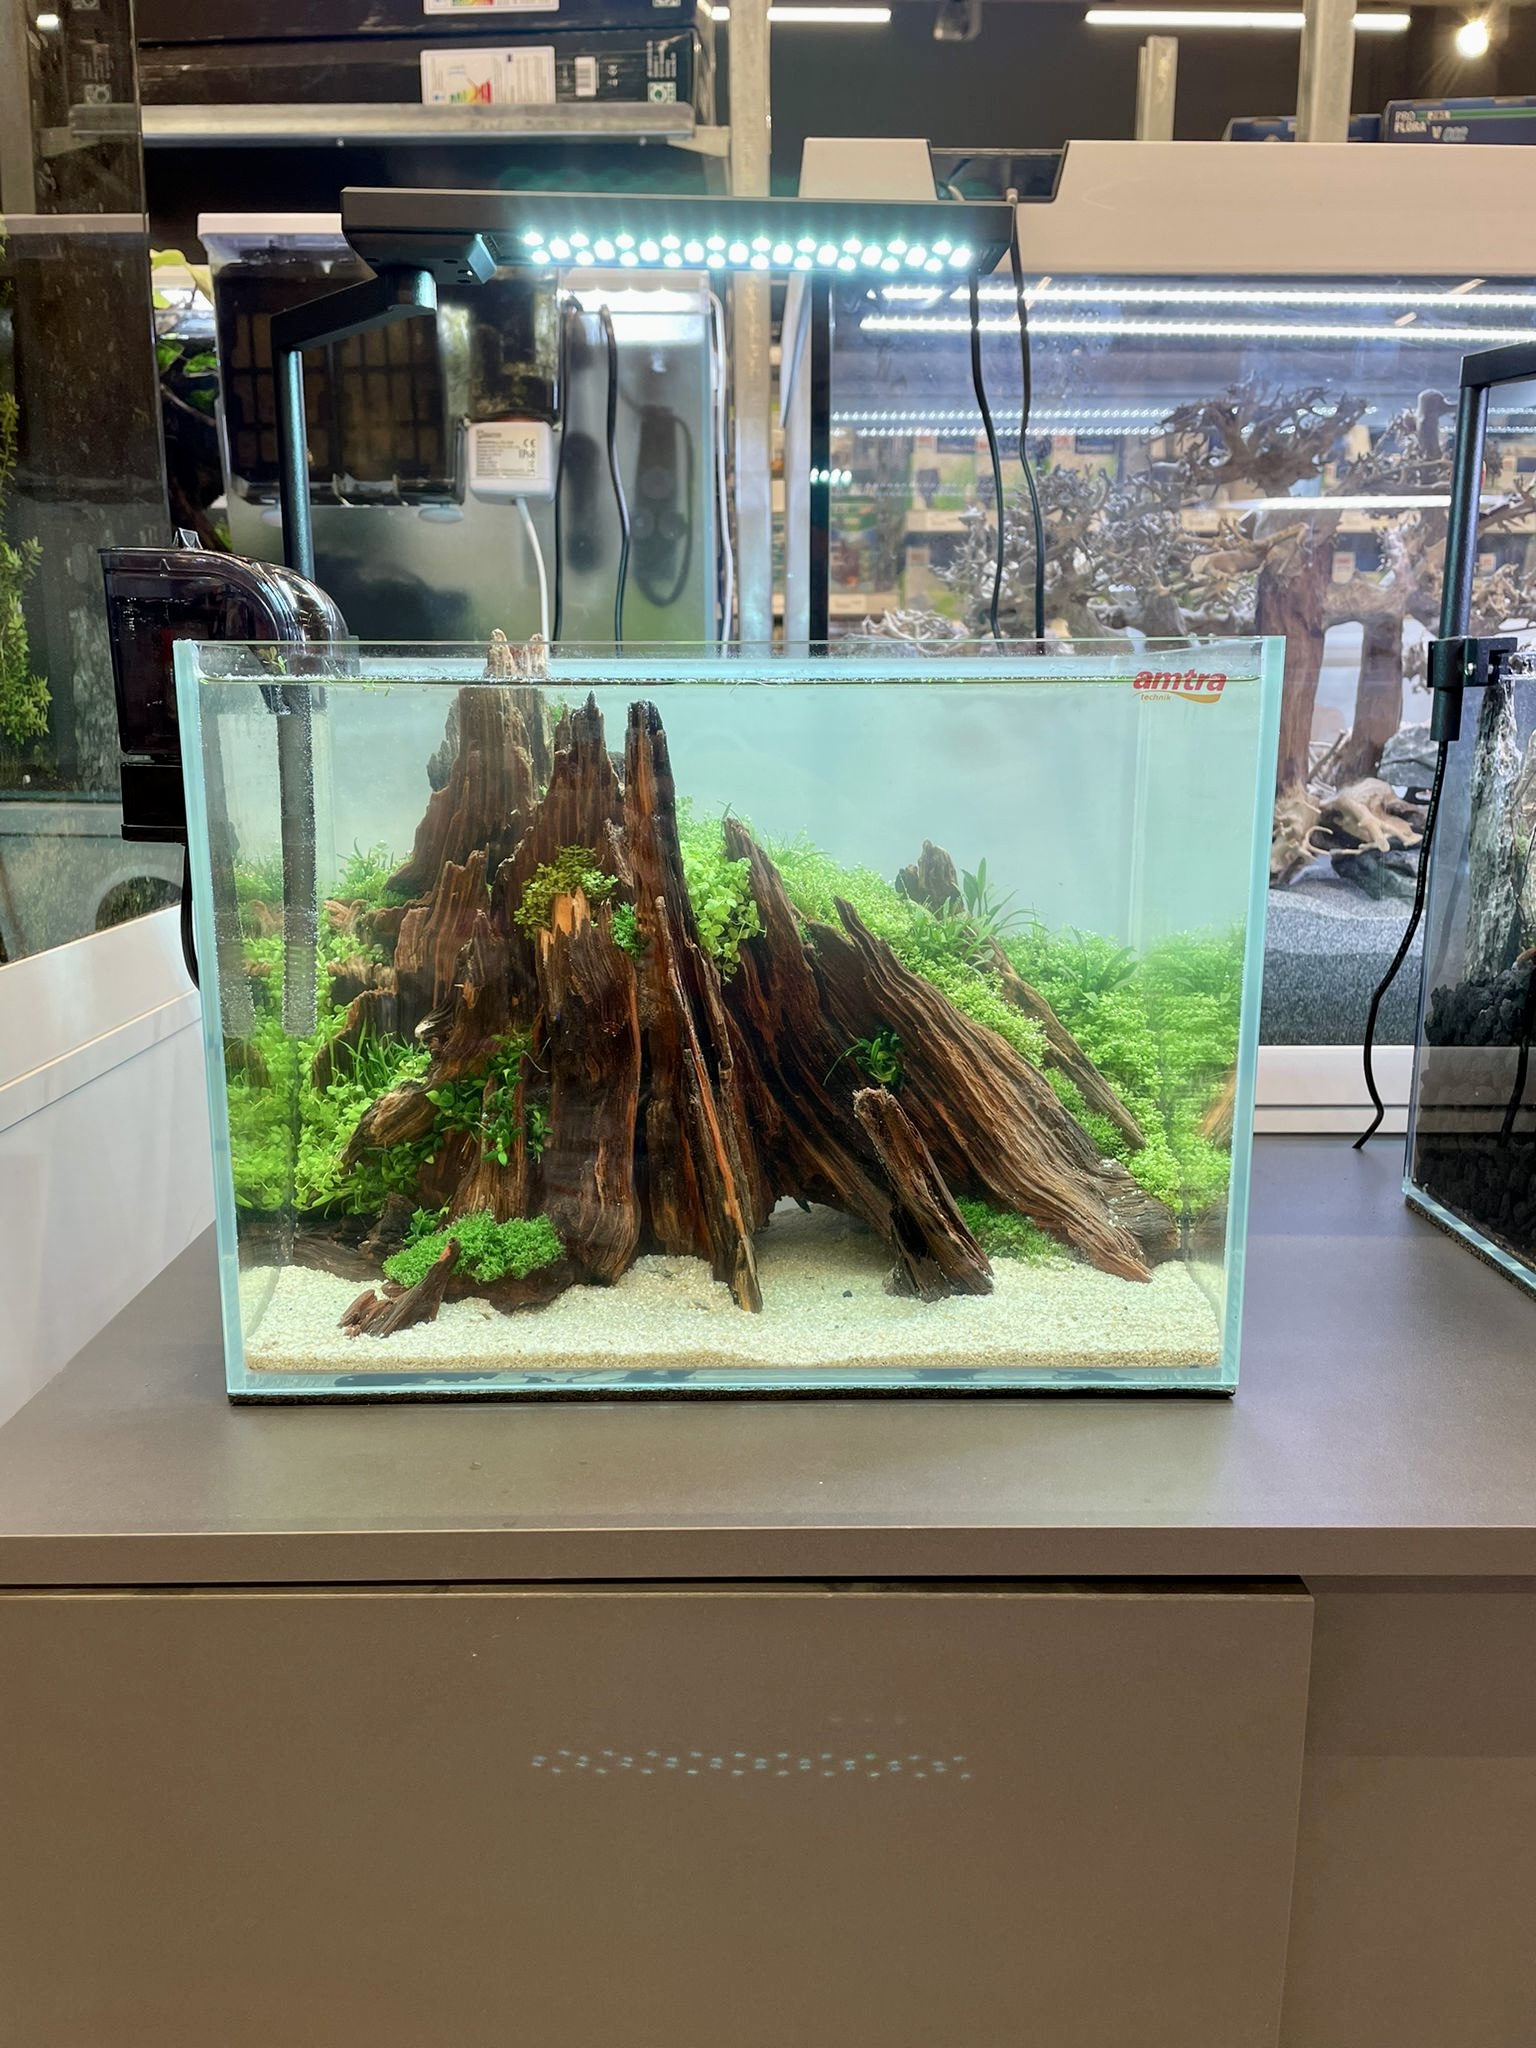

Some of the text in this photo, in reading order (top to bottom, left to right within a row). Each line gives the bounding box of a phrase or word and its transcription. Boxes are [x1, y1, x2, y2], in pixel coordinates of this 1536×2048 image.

[1395, 110, 1416, 121] PRO
[1133, 669, 1227, 691] amtra
[1140, 693, 1171, 701] technik
